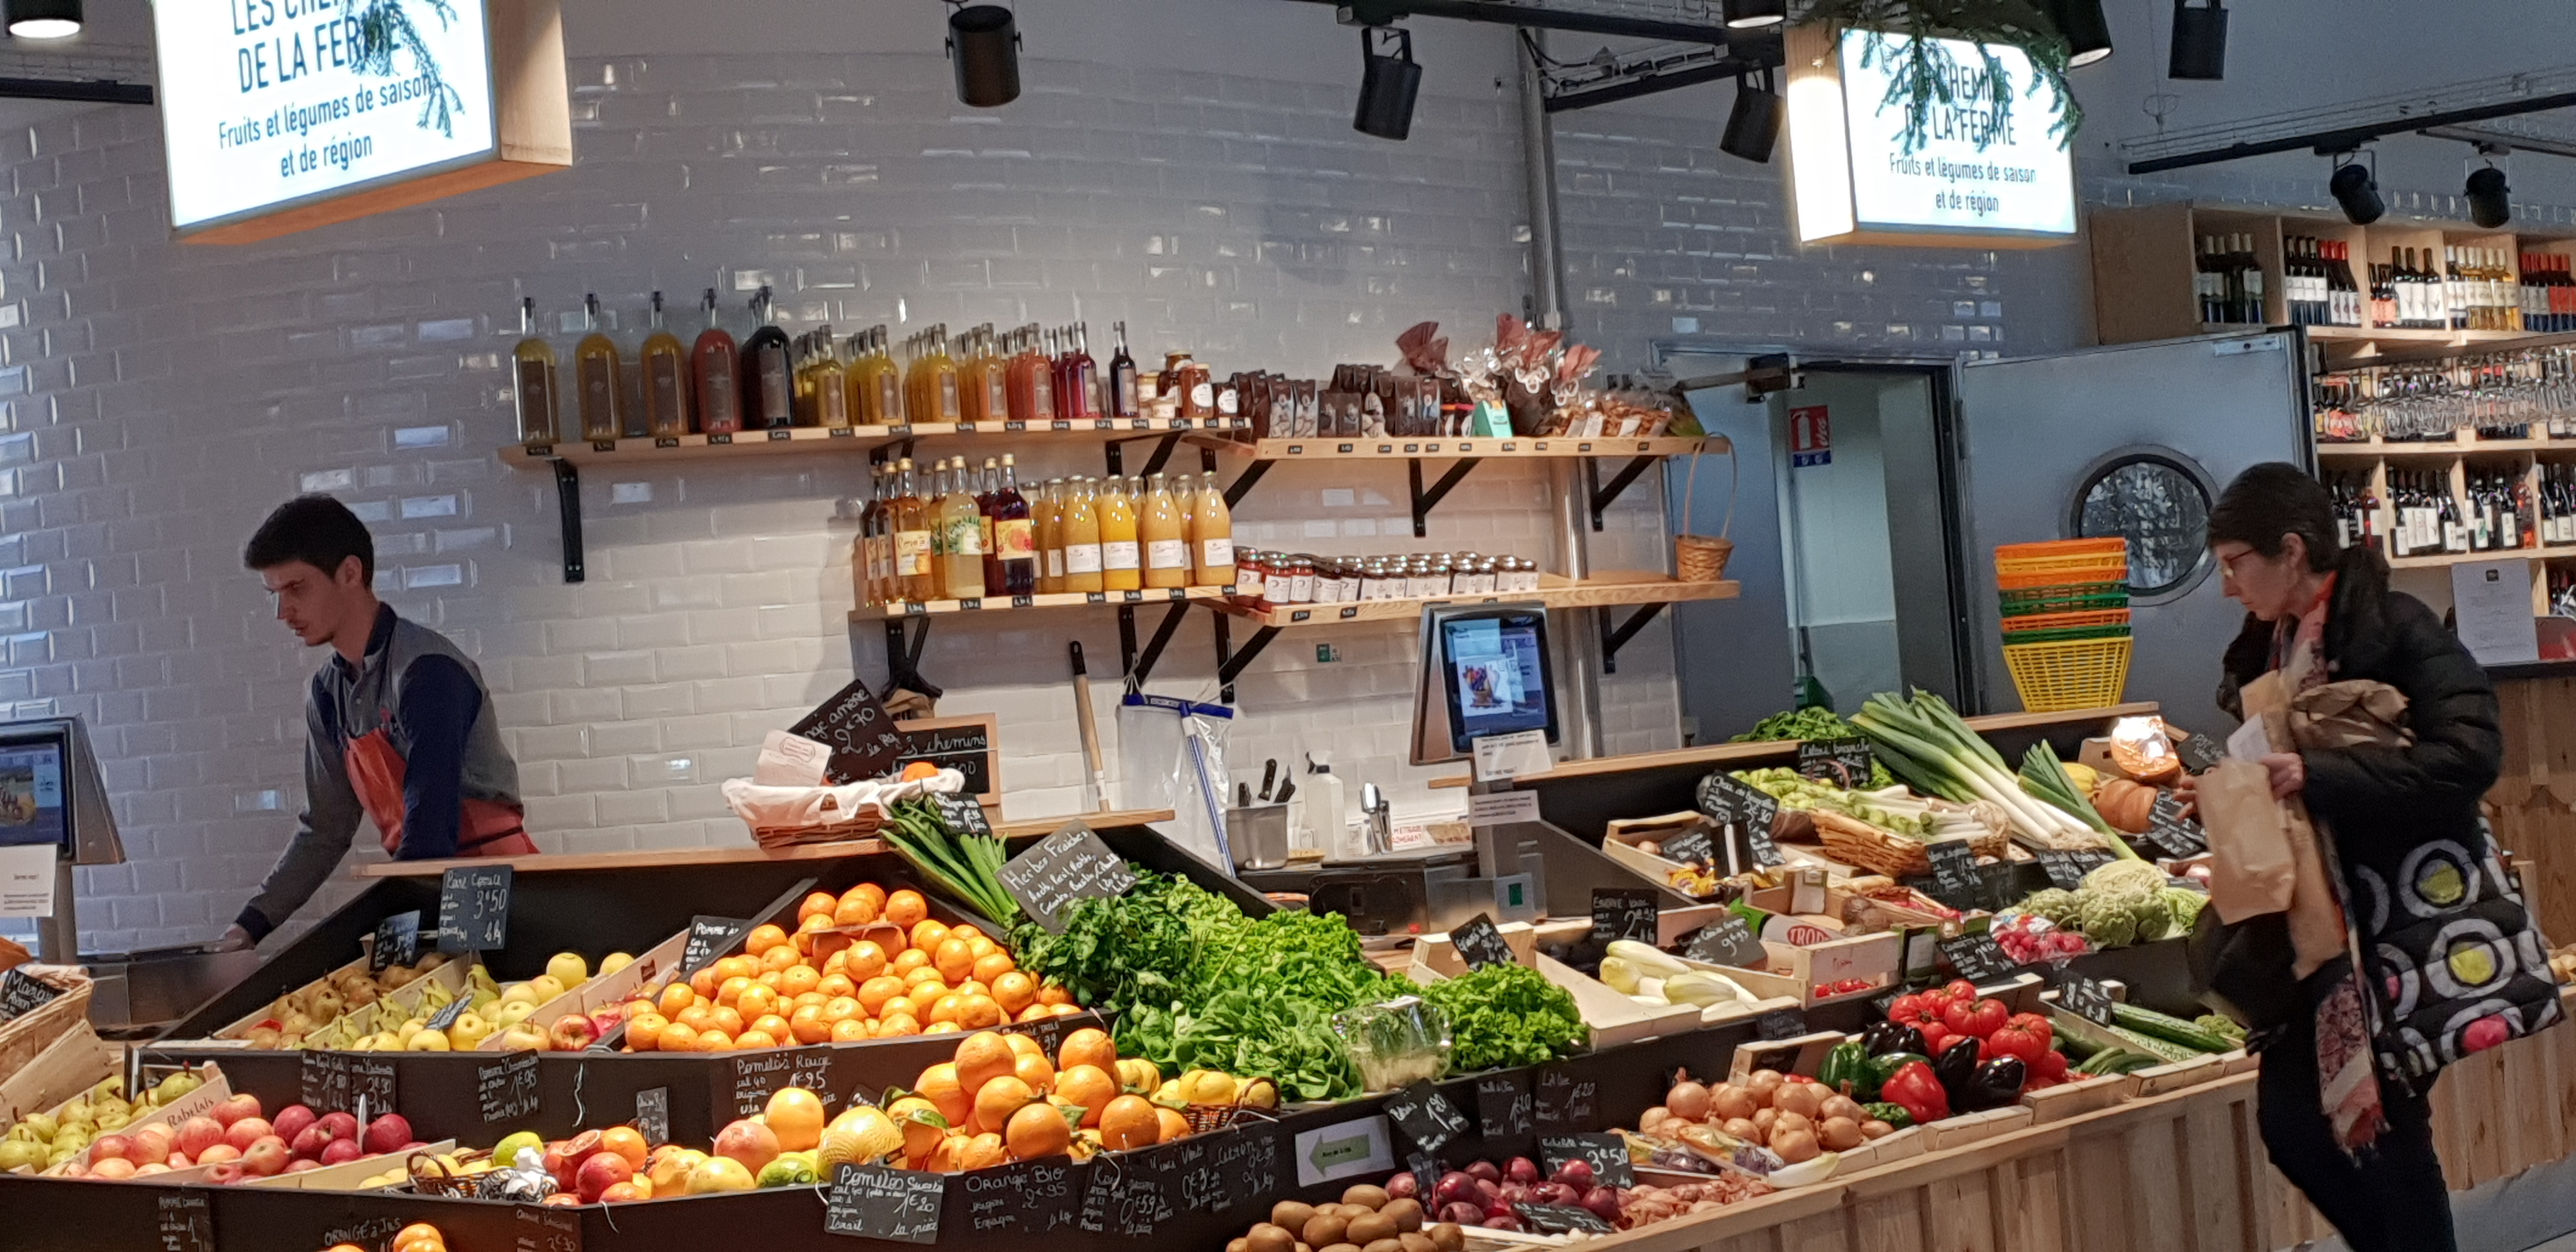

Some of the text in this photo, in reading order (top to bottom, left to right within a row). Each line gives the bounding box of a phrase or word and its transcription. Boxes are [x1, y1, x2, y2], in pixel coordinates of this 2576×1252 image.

[238, 42, 269, 93] DE
[276, 32, 307, 82] LA
[218, 74, 434, 149] Fruits et légumes de saison
[1932, 106, 1955, 141] LA
[281, 134, 372, 178] et de région
[1889, 153, 2037, 183] Fruits et légumes de saison
[1935, 190, 1999, 217] et de région
